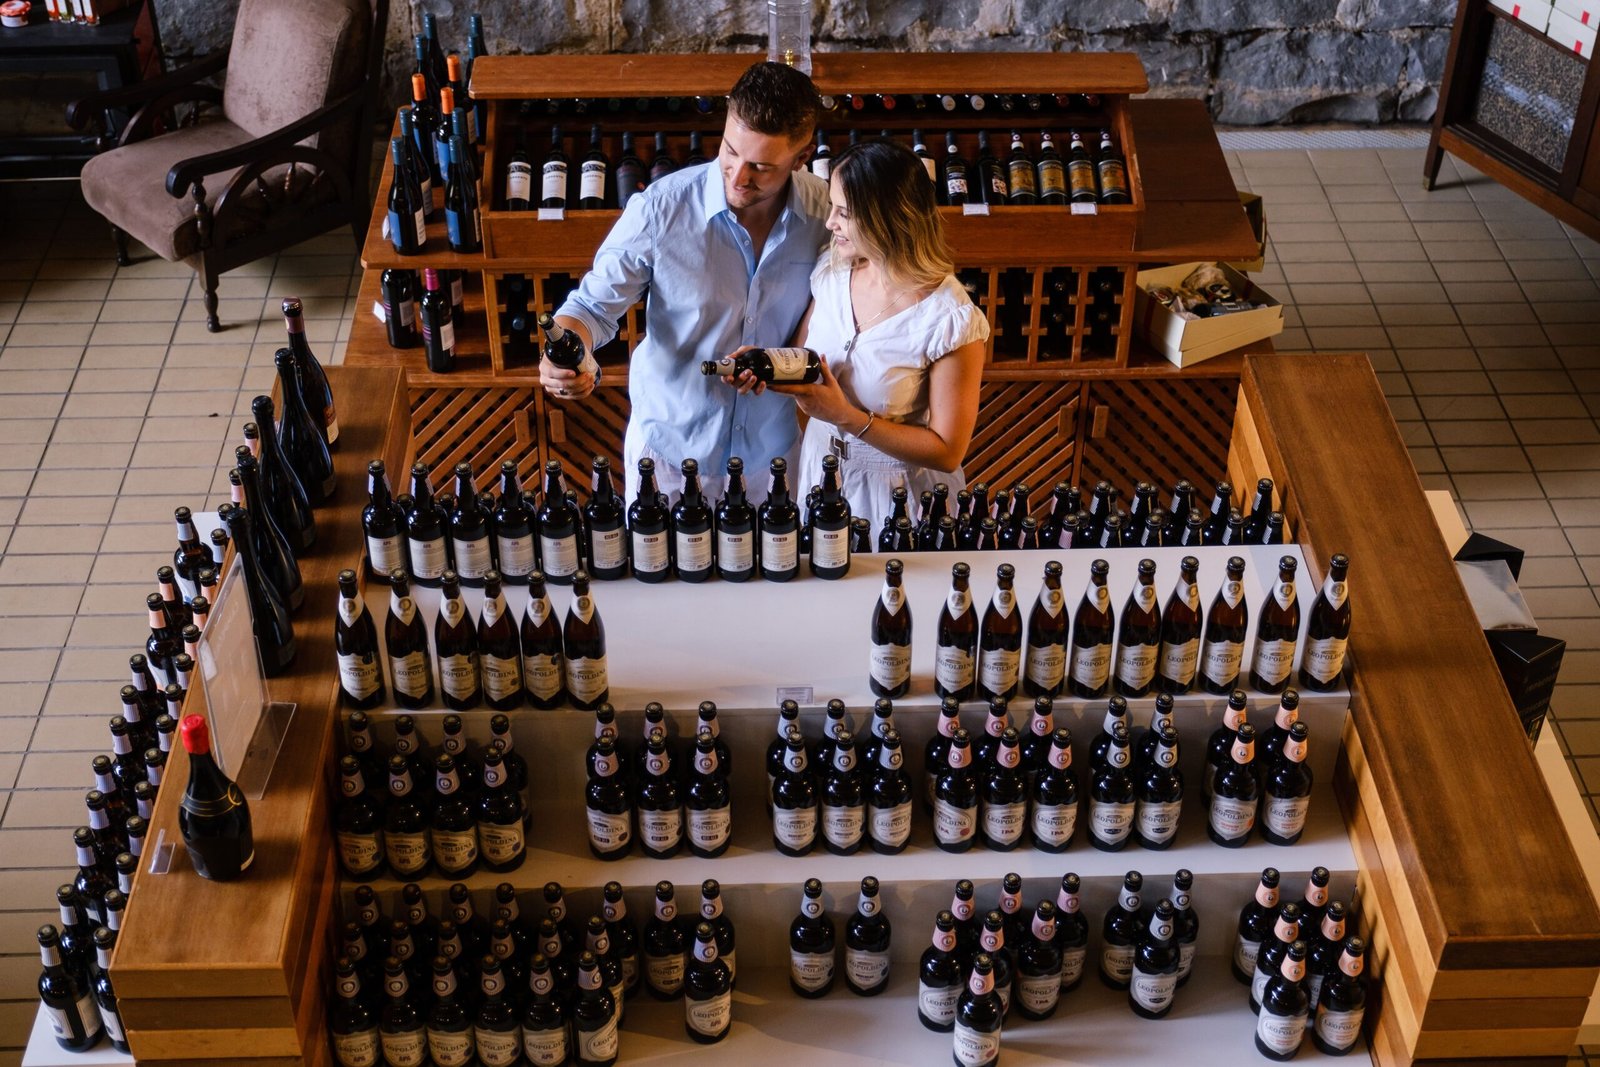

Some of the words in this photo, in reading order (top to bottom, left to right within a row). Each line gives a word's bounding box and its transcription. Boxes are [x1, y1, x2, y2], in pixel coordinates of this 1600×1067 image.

[873, 655, 910, 668] LEOPOLDIN
[987, 815, 1025, 826] LEOPOLDIN
[1037, 815, 1076, 826] LEOPOLDIN
